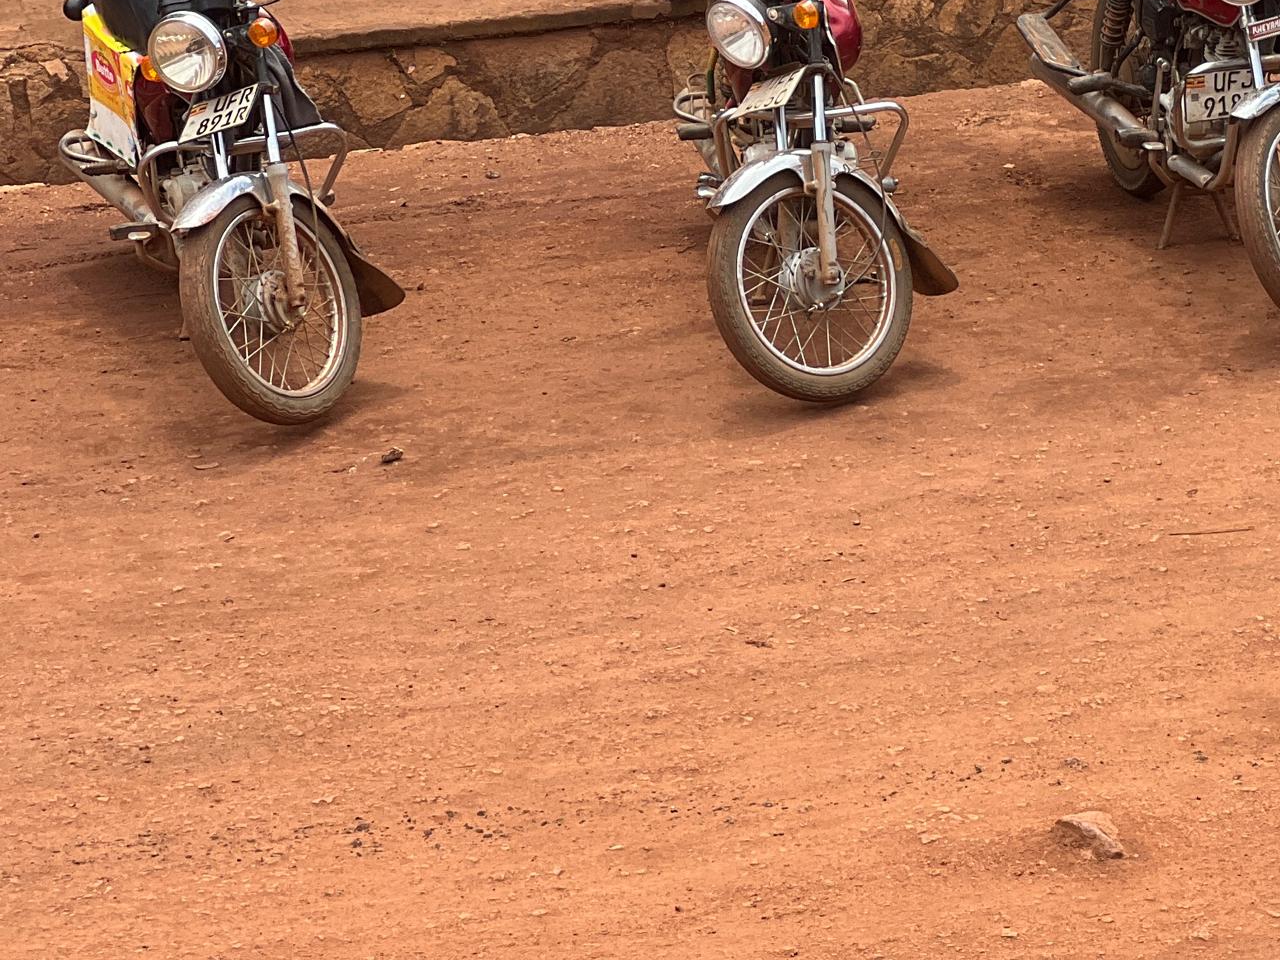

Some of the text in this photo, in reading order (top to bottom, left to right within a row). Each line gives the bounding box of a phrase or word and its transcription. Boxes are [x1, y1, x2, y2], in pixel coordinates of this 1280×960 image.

[213, 86, 254, 114] UFR
[1204, 92, 1256, 118] 918
[196, 105, 249, 136] 891R
